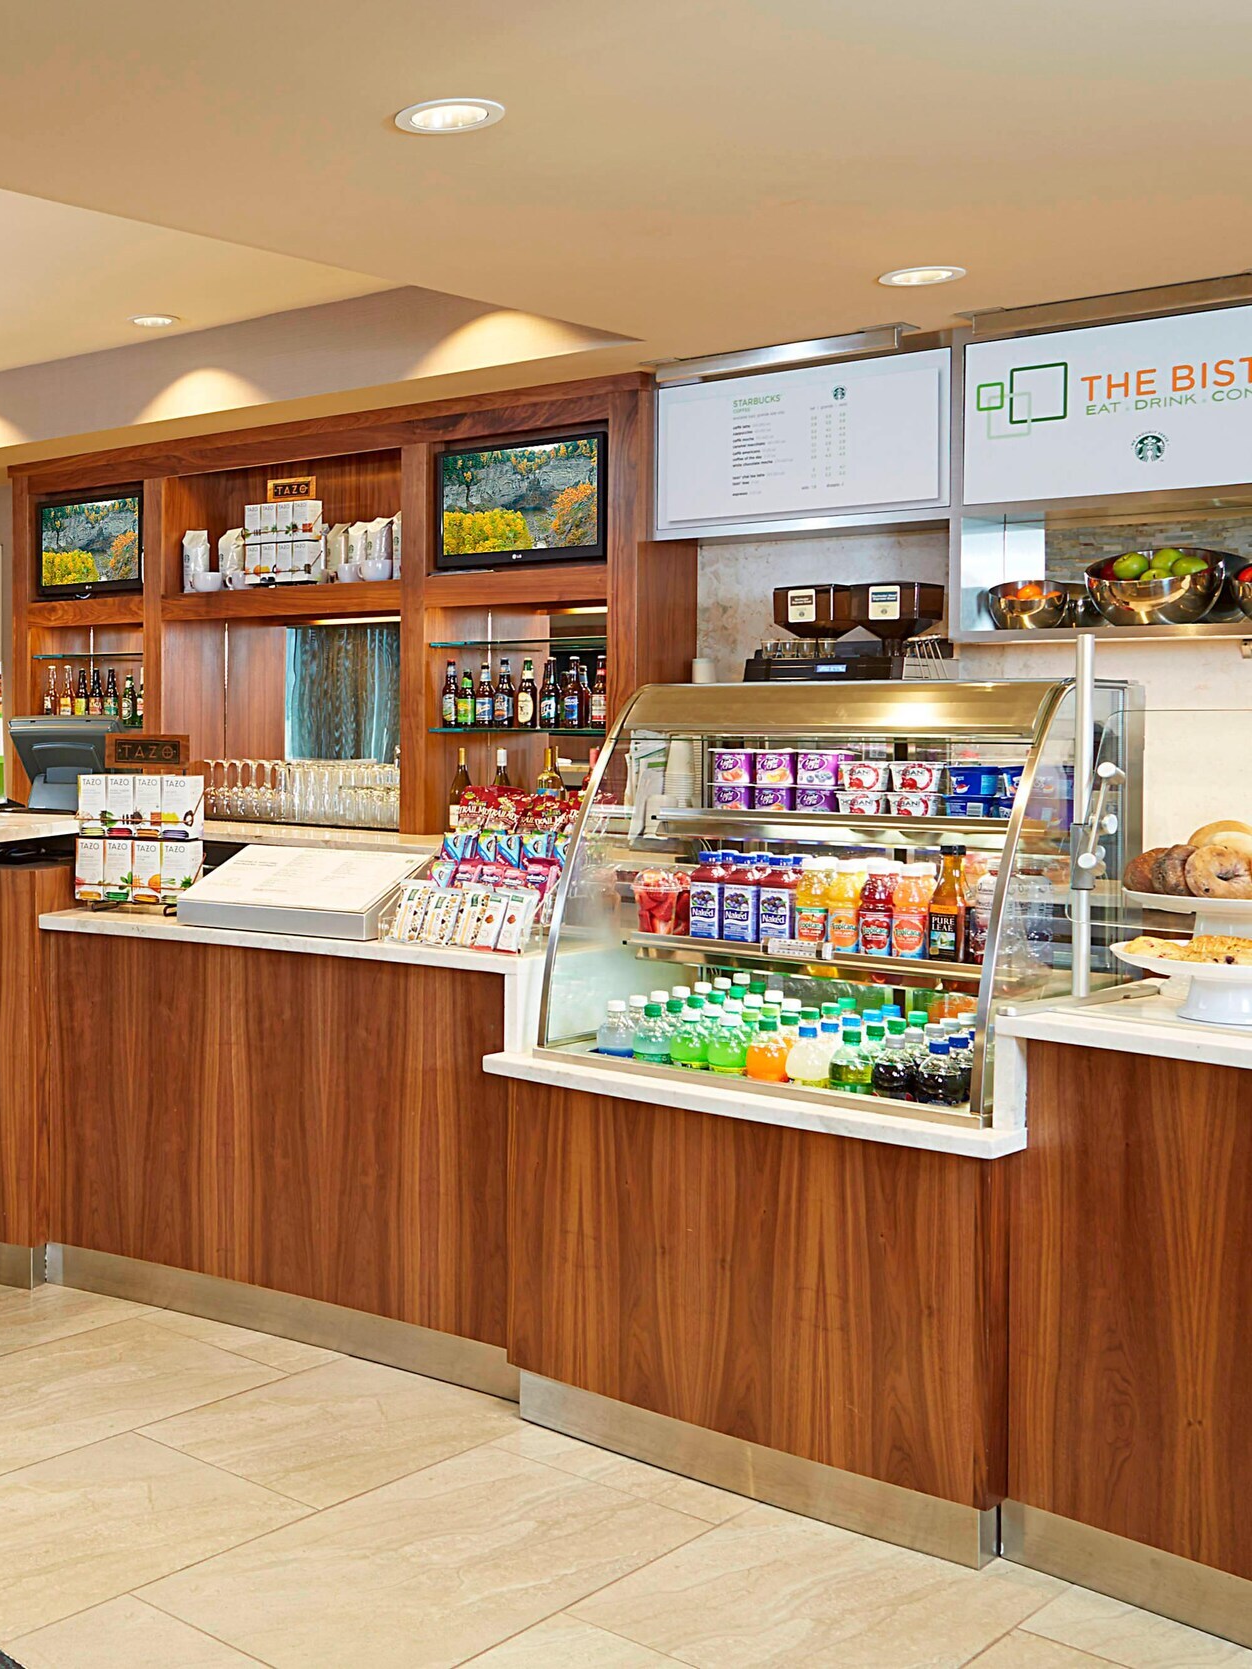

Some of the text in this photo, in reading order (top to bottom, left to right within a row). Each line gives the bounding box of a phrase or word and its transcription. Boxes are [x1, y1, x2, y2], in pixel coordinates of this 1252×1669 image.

[1080, 357, 1252, 401] THE BIST
[732, 394, 781, 408] STARBUCKS
[1086, 402, 1122, 416] EAT
[1135, 393, 1197, 411] DRINK
[276, 484, 308, 495] TAZO
[122, 744, 174, 759] TAZO
[82, 778, 102, 786] TAZO
[110, 778, 130, 786] TAZO
[166, 779, 186, 788] TAZO
[80, 842, 100, 850] TAZO
[108, 842, 128, 851] TAZO
[137, 844, 157, 853] TAZO
[165, 845, 186, 854] TAZO
[692, 908, 714, 917] Naked
[725, 911, 748, 920] Naked
[762, 914, 785, 924] Naked
[931, 916, 955, 926] PURE
[799, 921, 824, 930] Tropicana
[831, 922, 857, 931] Tropicana
[862, 926, 888, 935] Tropicana
[895, 928, 921, 937] Tropicana
